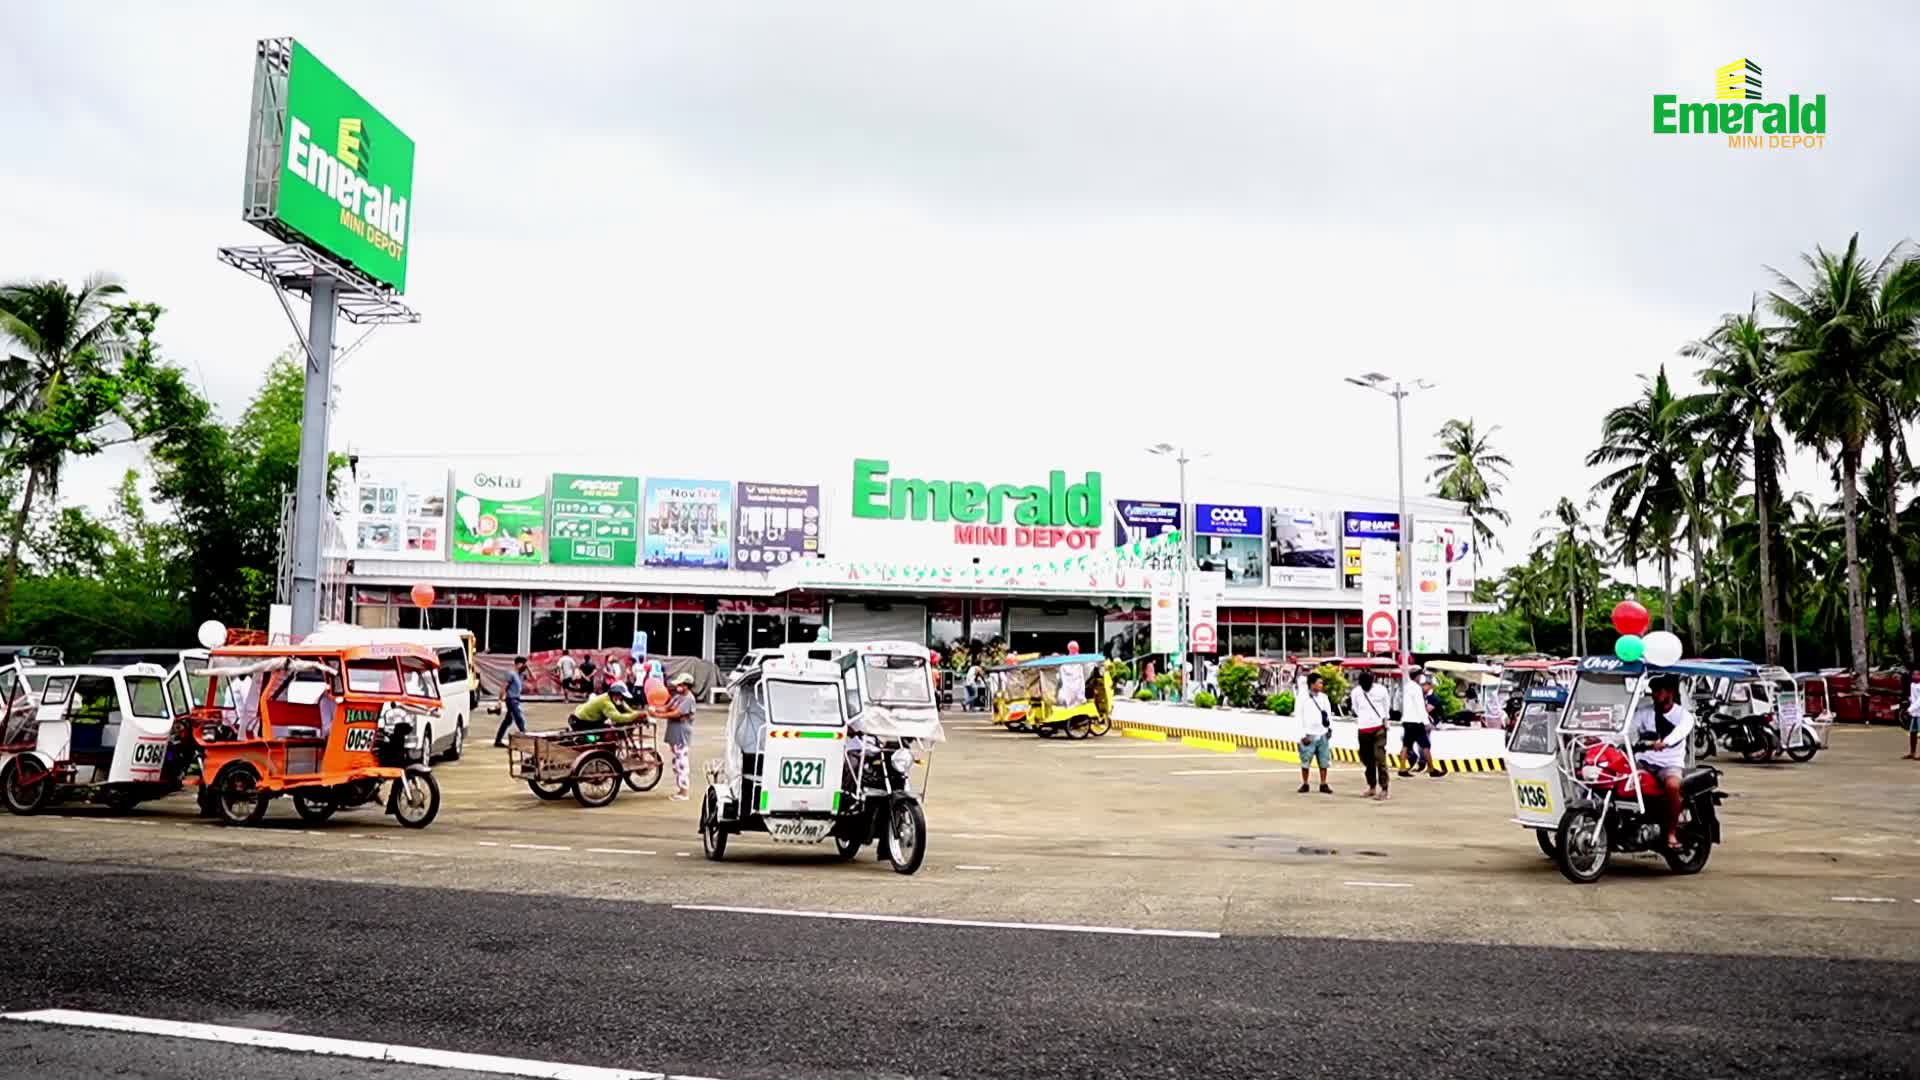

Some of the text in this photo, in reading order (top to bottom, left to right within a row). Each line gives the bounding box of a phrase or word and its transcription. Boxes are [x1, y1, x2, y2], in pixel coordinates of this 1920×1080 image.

[287, 115, 407, 241] Emerald
[339, 207, 403, 261] MINI DEPOT
[851, 458, 1103, 528] Emerald
[1210, 508, 1248, 523] COOL
[953, 525, 1102, 550] MINI DEPOT
[781, 761, 822, 785] 0321
[1517, 784, 1547, 807] 0136
[774, 823, 801, 835] TAYO
